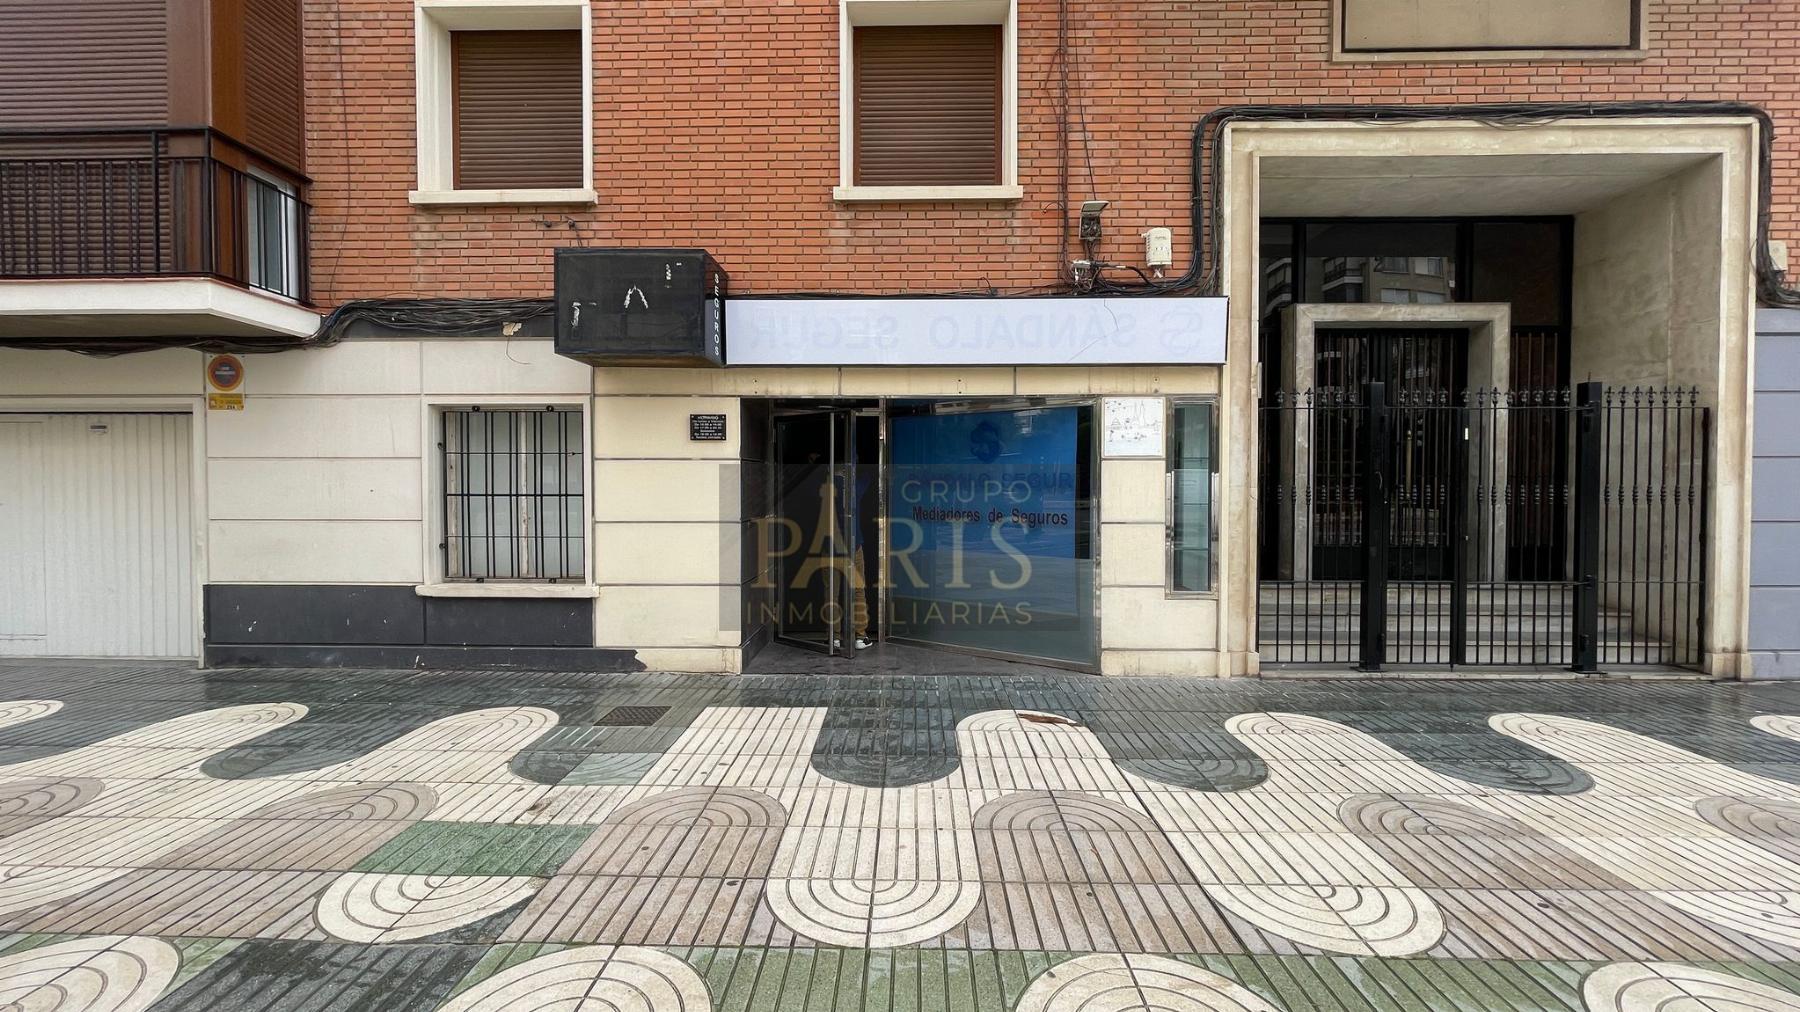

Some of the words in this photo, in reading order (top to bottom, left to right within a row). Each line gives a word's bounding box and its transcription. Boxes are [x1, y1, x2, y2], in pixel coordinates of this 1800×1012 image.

[912, 505, 980, 522] Mediadores
[988, 507, 1003, 522] de
[1011, 508, 1069, 528] Seguros
